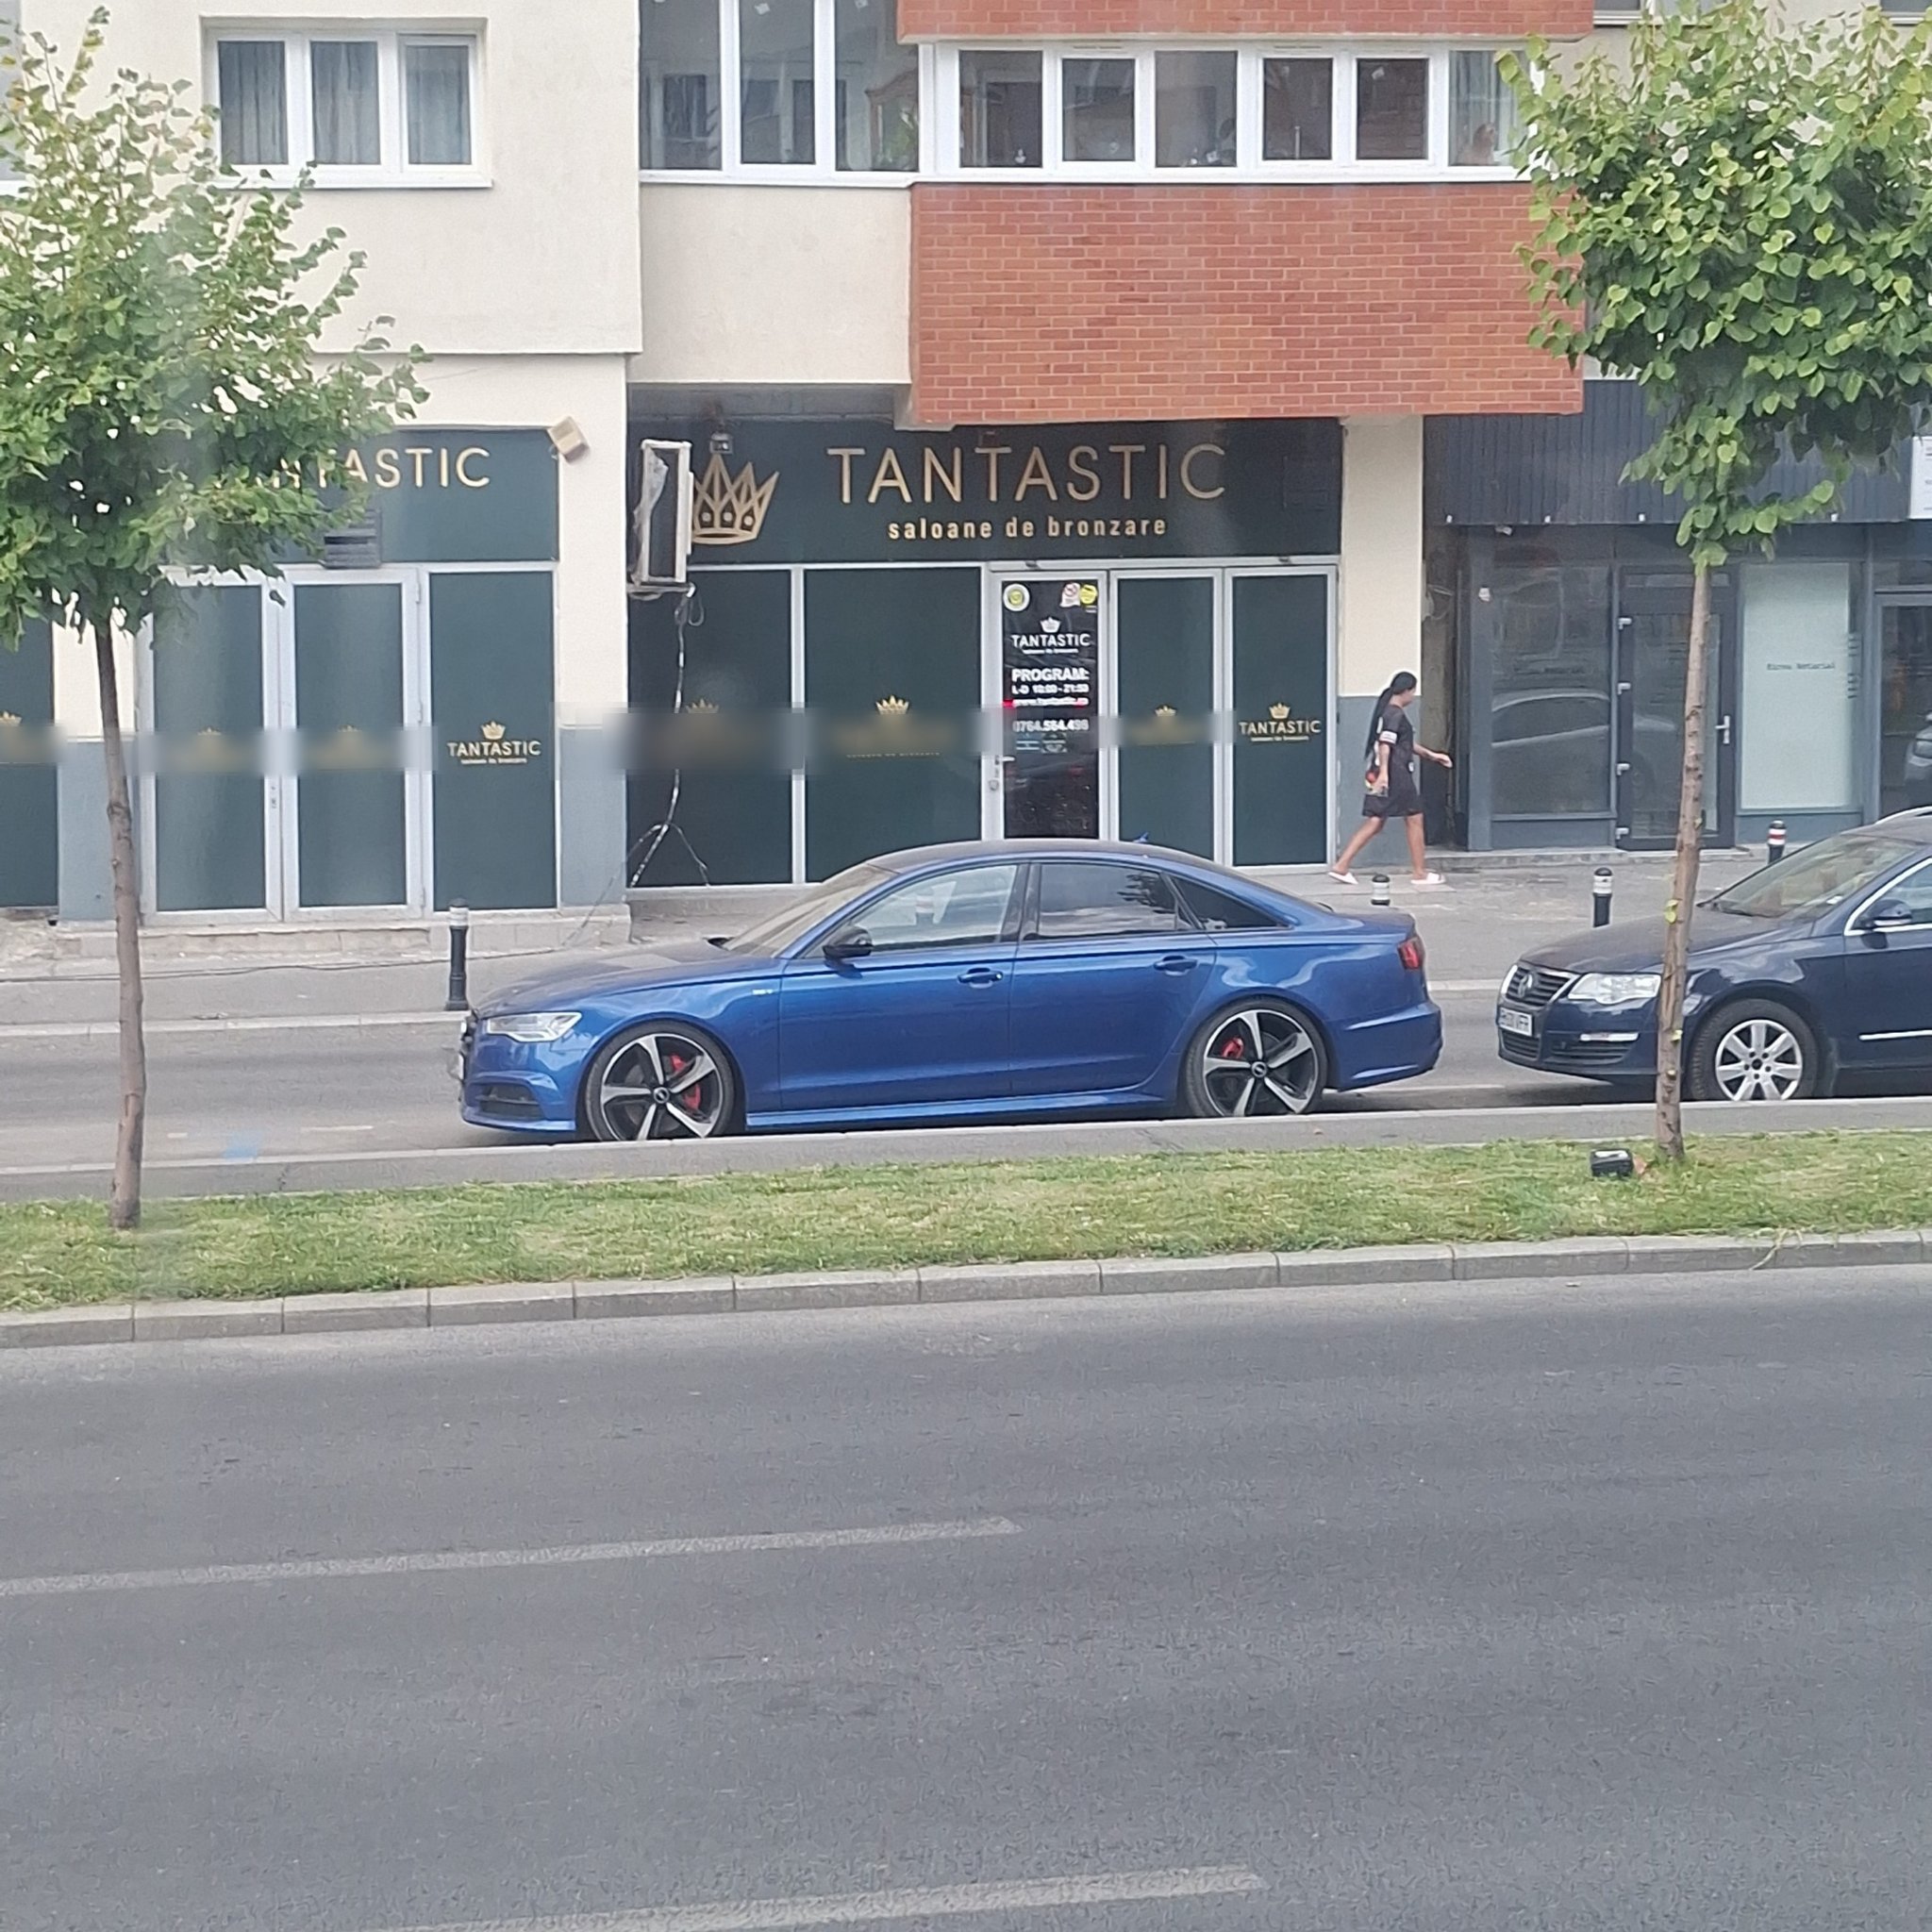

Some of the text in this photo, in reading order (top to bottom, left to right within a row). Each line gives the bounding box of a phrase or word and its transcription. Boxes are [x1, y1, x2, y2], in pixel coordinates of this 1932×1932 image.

[826, 443, 1225, 504] TANTASTIC
[888, 515, 1167, 541] saloane de bronzare
[1010, 633, 1091, 648] TANTASTIC
[1239, 720, 1322, 735] TANTASTIC
[446, 741, 541, 757] TANTASTIC
